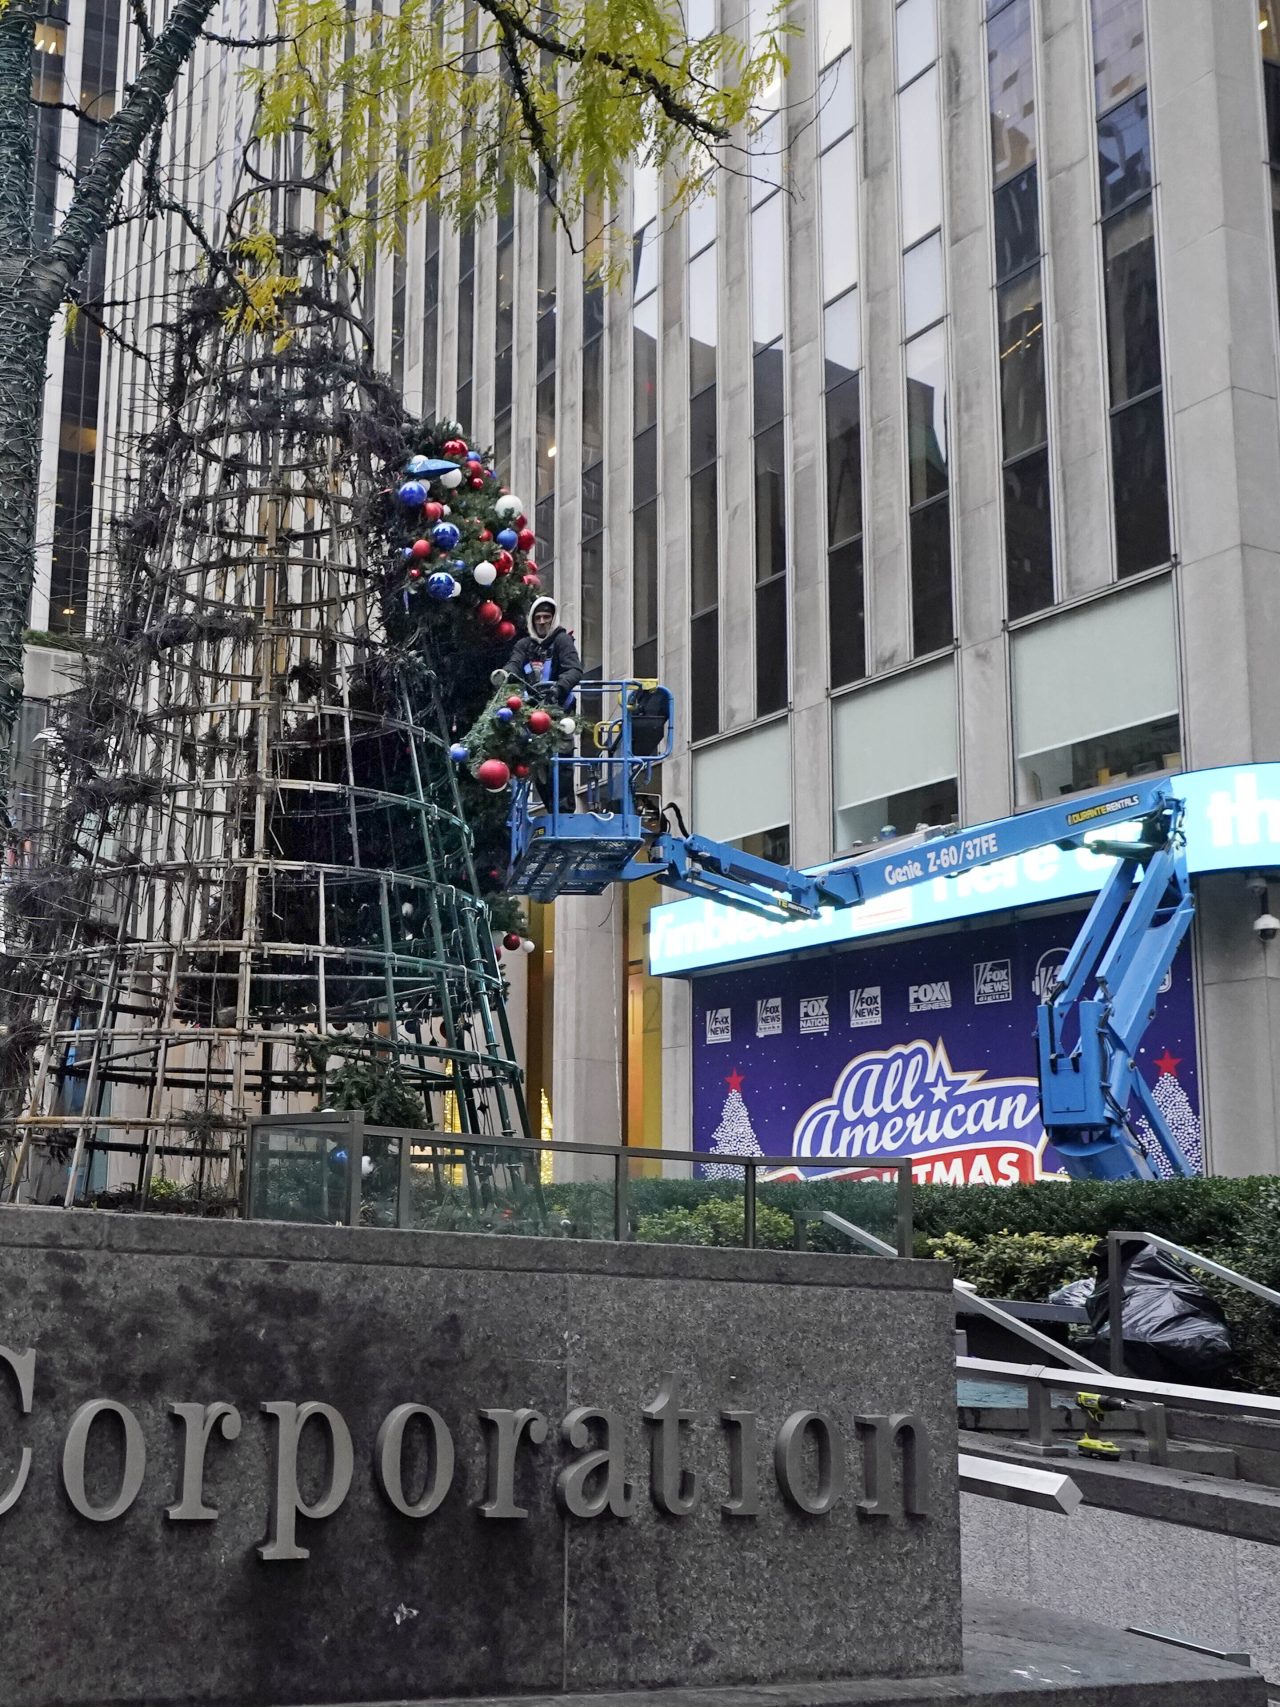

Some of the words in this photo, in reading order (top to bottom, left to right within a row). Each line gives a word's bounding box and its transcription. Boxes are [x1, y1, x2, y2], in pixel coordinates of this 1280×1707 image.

[884, 860, 924, 886] Genie
[927, 833, 998, 874] Z-60/37FE
[985, 969, 1008, 982] FOX
[909, 982, 944, 1004] FOX
[980, 981, 1009, 994] NEWS
[860, 995, 879, 1007] FOX
[909, 1001, 952, 1012] BUSINESS
[765, 1005, 780, 1015] FOX
[800, 999, 828, 1018] FOX
[855, 1007, 880, 1018] NEWS
[761, 1014, 781, 1024] NEWS
[800, 1018, 829, 1028] NATION
[710, 1026, 730, 1036] NEWS
[843, 1054, 924, 1122] All
[800, 1093, 1040, 1158] American
